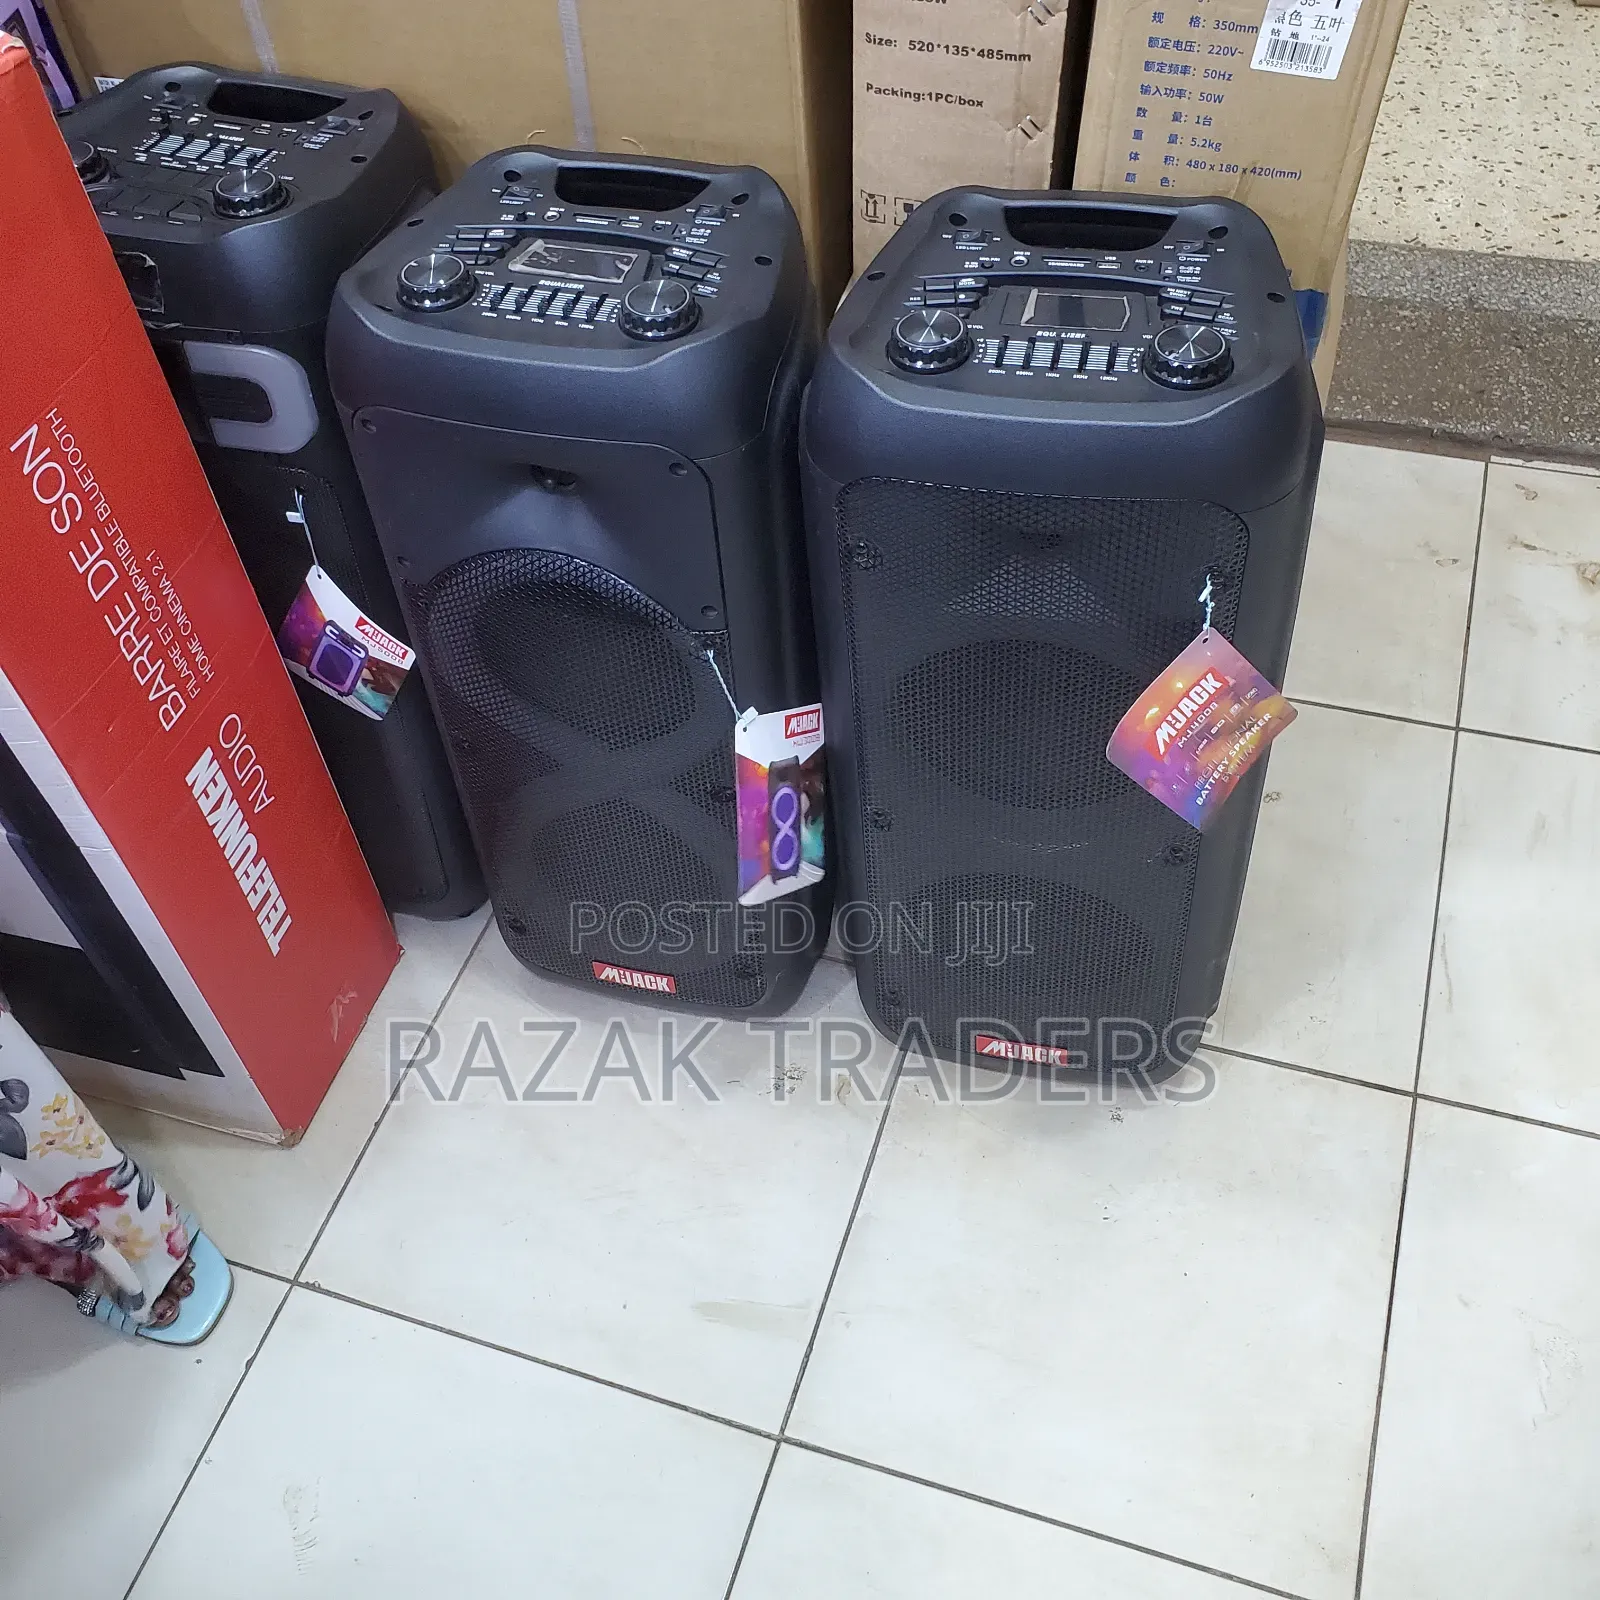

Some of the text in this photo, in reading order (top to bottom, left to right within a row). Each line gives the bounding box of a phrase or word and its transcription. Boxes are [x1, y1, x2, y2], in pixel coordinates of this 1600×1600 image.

[864, 32, 898, 48] Size:
[1213, 20, 1258, 34] 350mm
[1198, 92, 1224, 104] 50W
[1203, 68, 1234, 81] 50Hz
[1186, 159, 1206, 170] 480
[1219, 163, 1238, 174] 180
[1250, 166, 1302, 180] 420(mm)
[1190, 137, 1222, 152] 5.2kg
[10, 424, 186, 732] BARRE DE SON
[46, 408, 200, 699] FILAIRE ET COMPATIBLE BLUETOOTH
[146, 550, 214, 682] HOME CINEMA 2.1
[219, 713, 275, 814] AUDIO
[1196, 757, 1229, 806] BATTERY
[1229, 712, 1272, 758] SPEAKER
[185, 746, 292, 958] TELEFUNKEN
